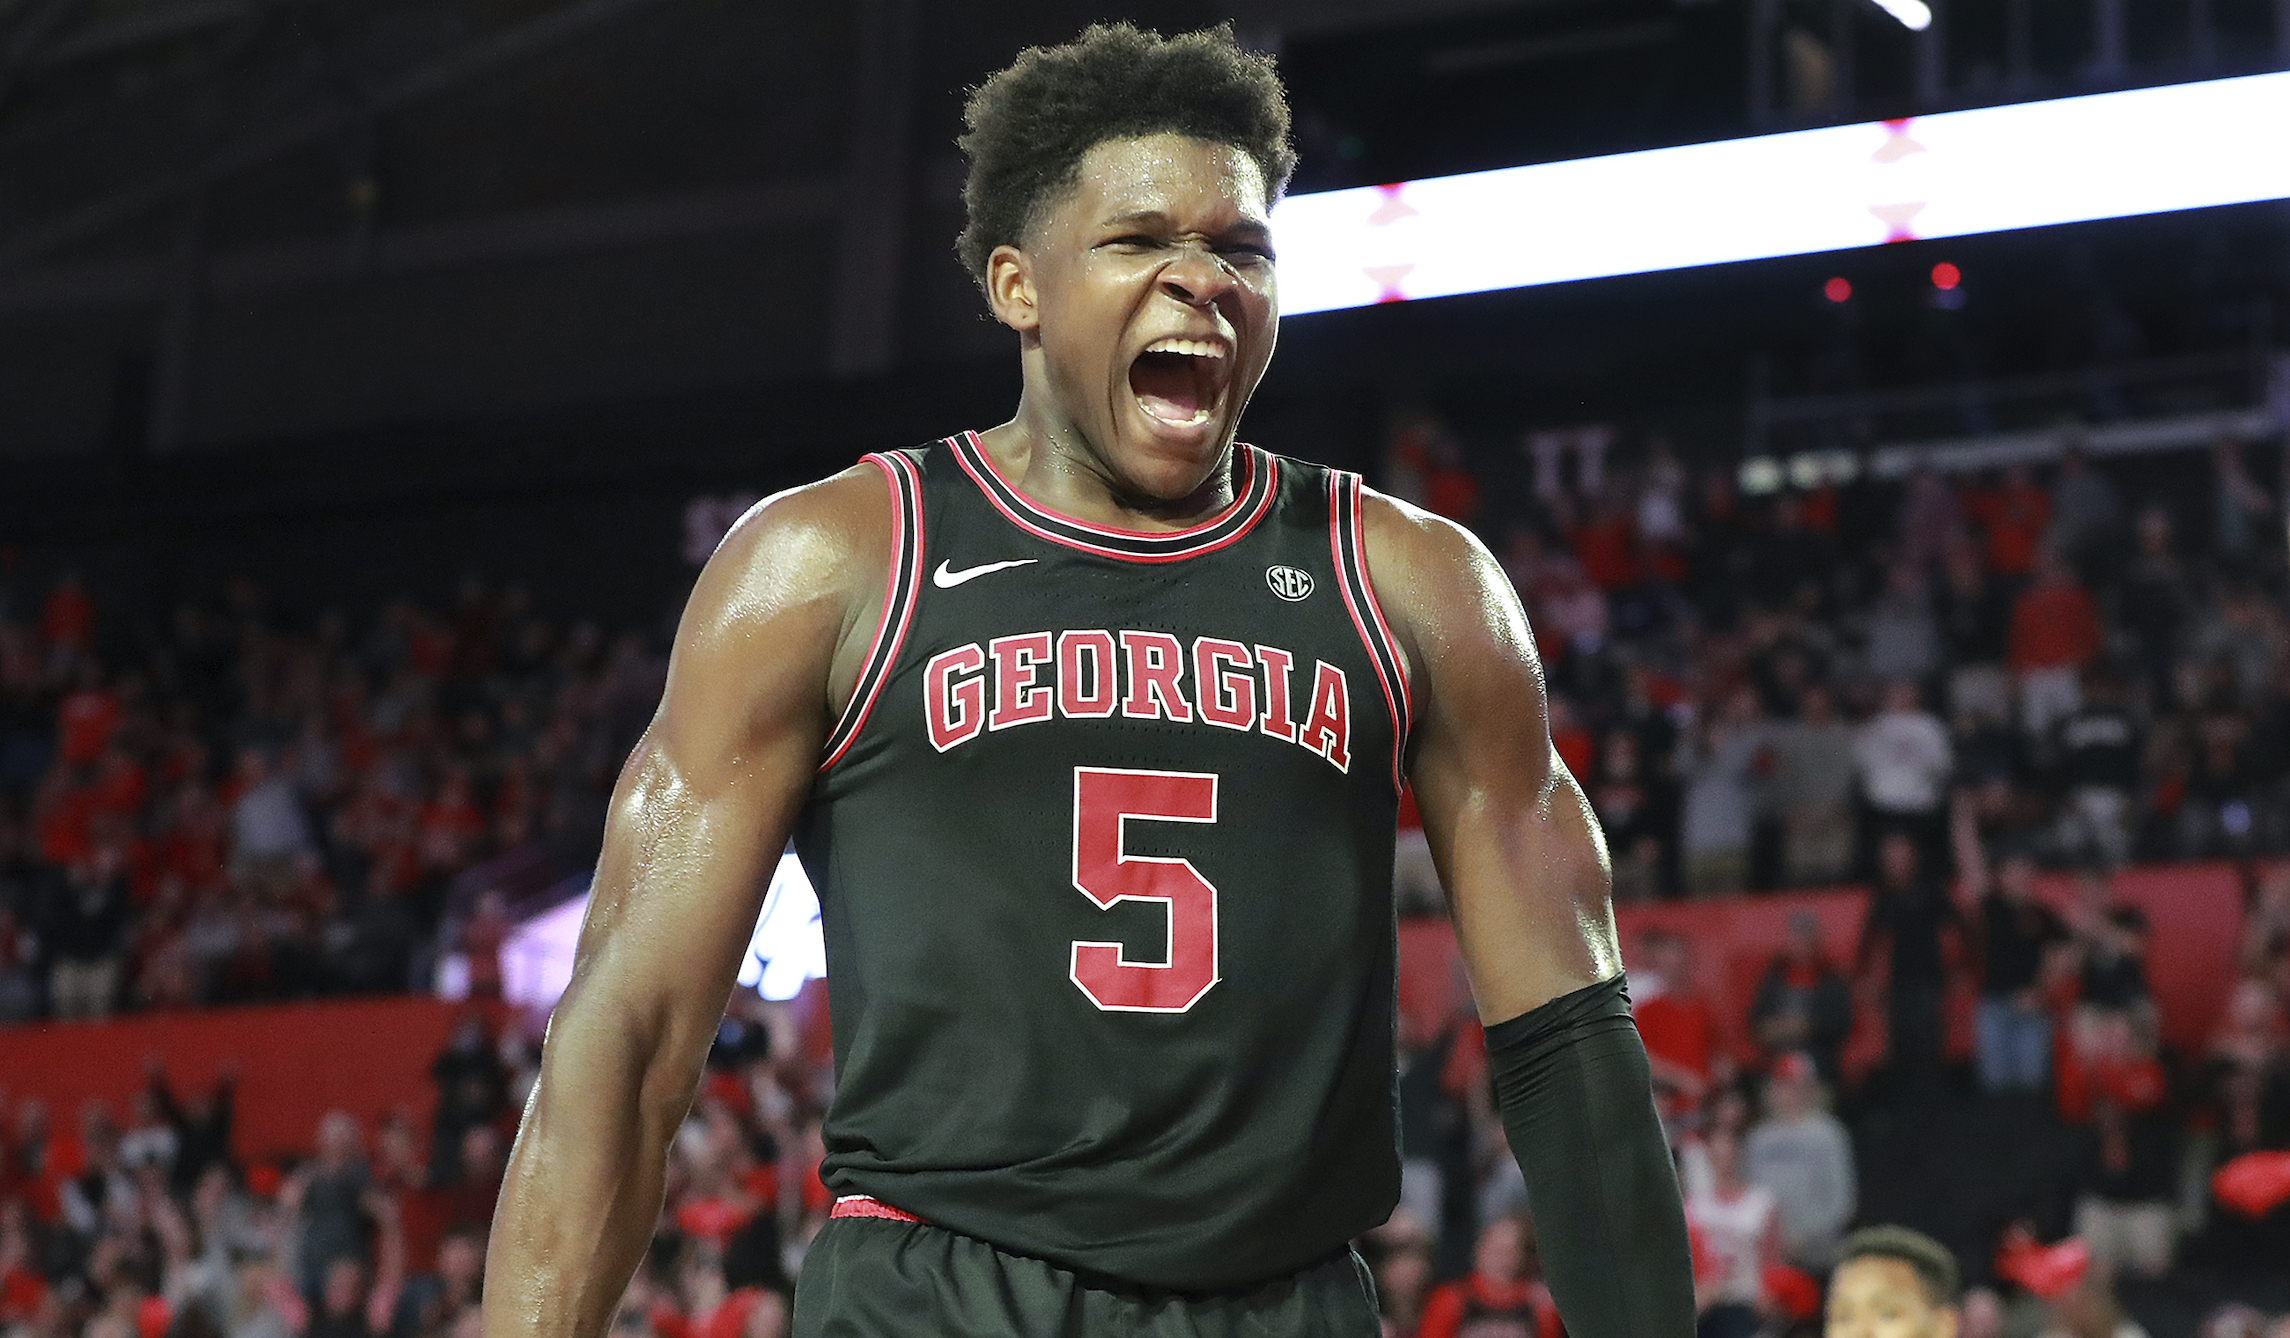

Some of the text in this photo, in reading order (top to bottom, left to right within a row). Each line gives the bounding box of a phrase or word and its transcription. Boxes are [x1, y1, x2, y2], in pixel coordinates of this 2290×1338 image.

[1269, 566, 1311, 598] SEC
[923, 629, 1351, 774] GEORGIA
[1069, 766, 1219, 1013] 5
